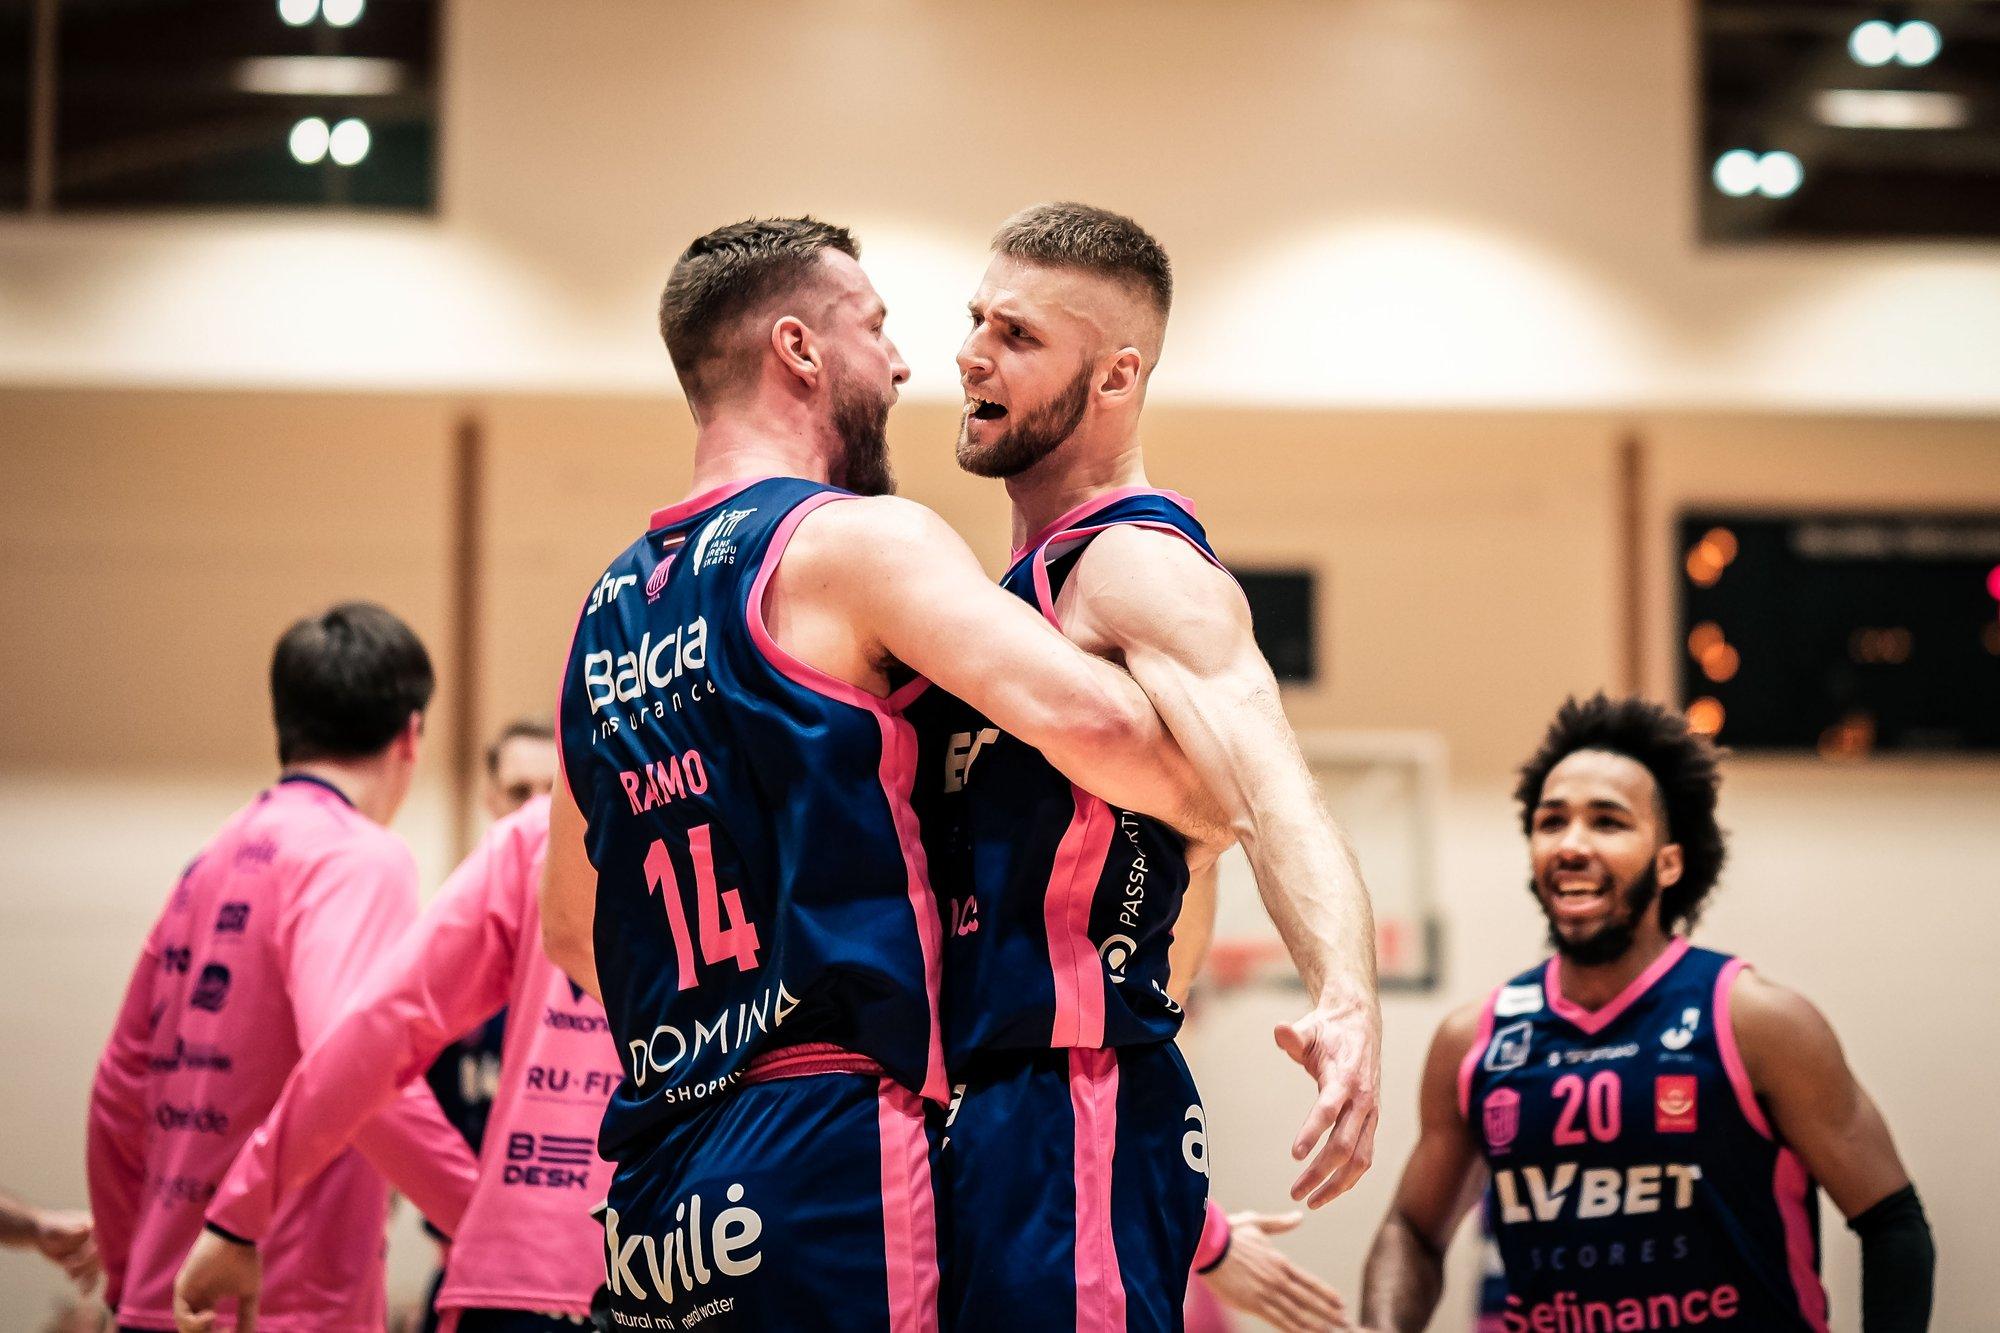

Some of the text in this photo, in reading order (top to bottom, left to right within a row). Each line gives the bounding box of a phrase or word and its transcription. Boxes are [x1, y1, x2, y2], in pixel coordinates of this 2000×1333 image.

[584, 615, 708, 715] Balcia
[592, 680, 716, 746] insurance
[643, 823, 760, 991] 14
[629, 979, 801, 1088] DOMINA
[1551, 1070, 1622, 1146] 20
[503, 1165, 589, 1190] DESK
[605, 1183, 763, 1305] kvilė
[1528, 1235, 1690, 1272] SCORES
[699, 1296, 735, 1320] water
